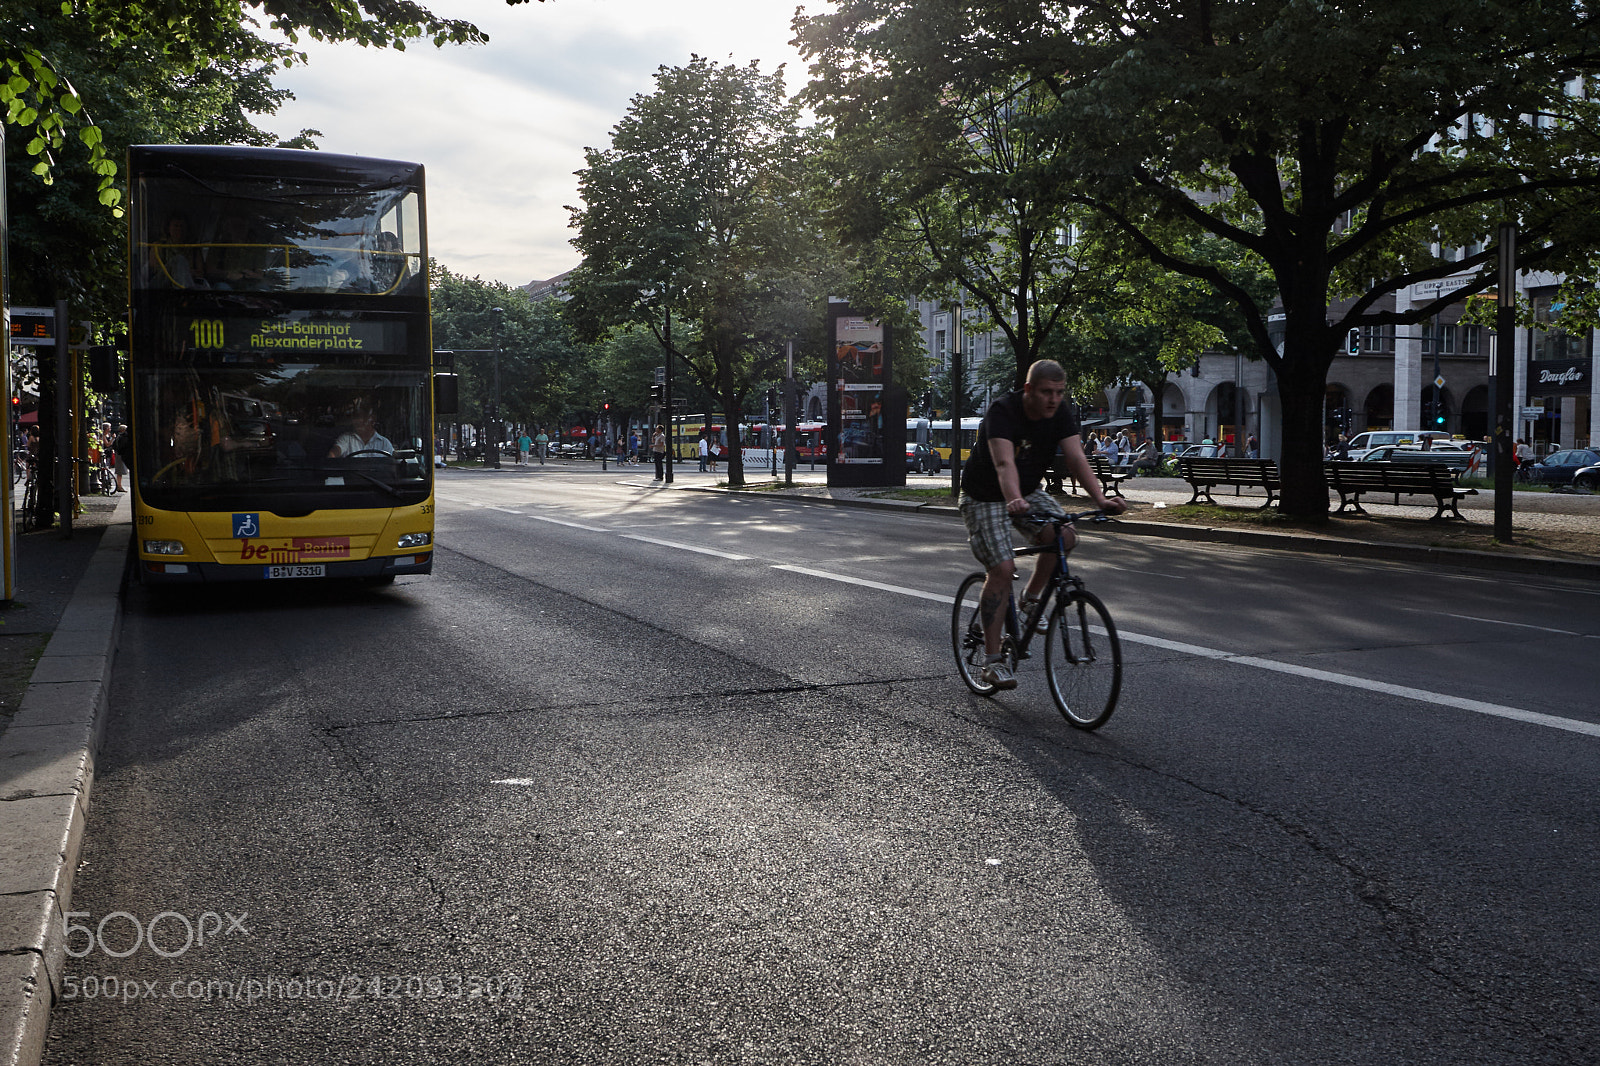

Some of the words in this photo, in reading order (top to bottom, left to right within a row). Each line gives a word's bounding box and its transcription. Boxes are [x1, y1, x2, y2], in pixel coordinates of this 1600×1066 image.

[189, 319, 225, 349] 100
[261, 320, 351, 335] S+U-Bahnhof
[250, 334, 363, 350] Alexanderplatz
[1539, 366, 1584, 386] Douglas
[303, 542, 345, 554] Berlin
[296, 566, 322, 576] 3310
